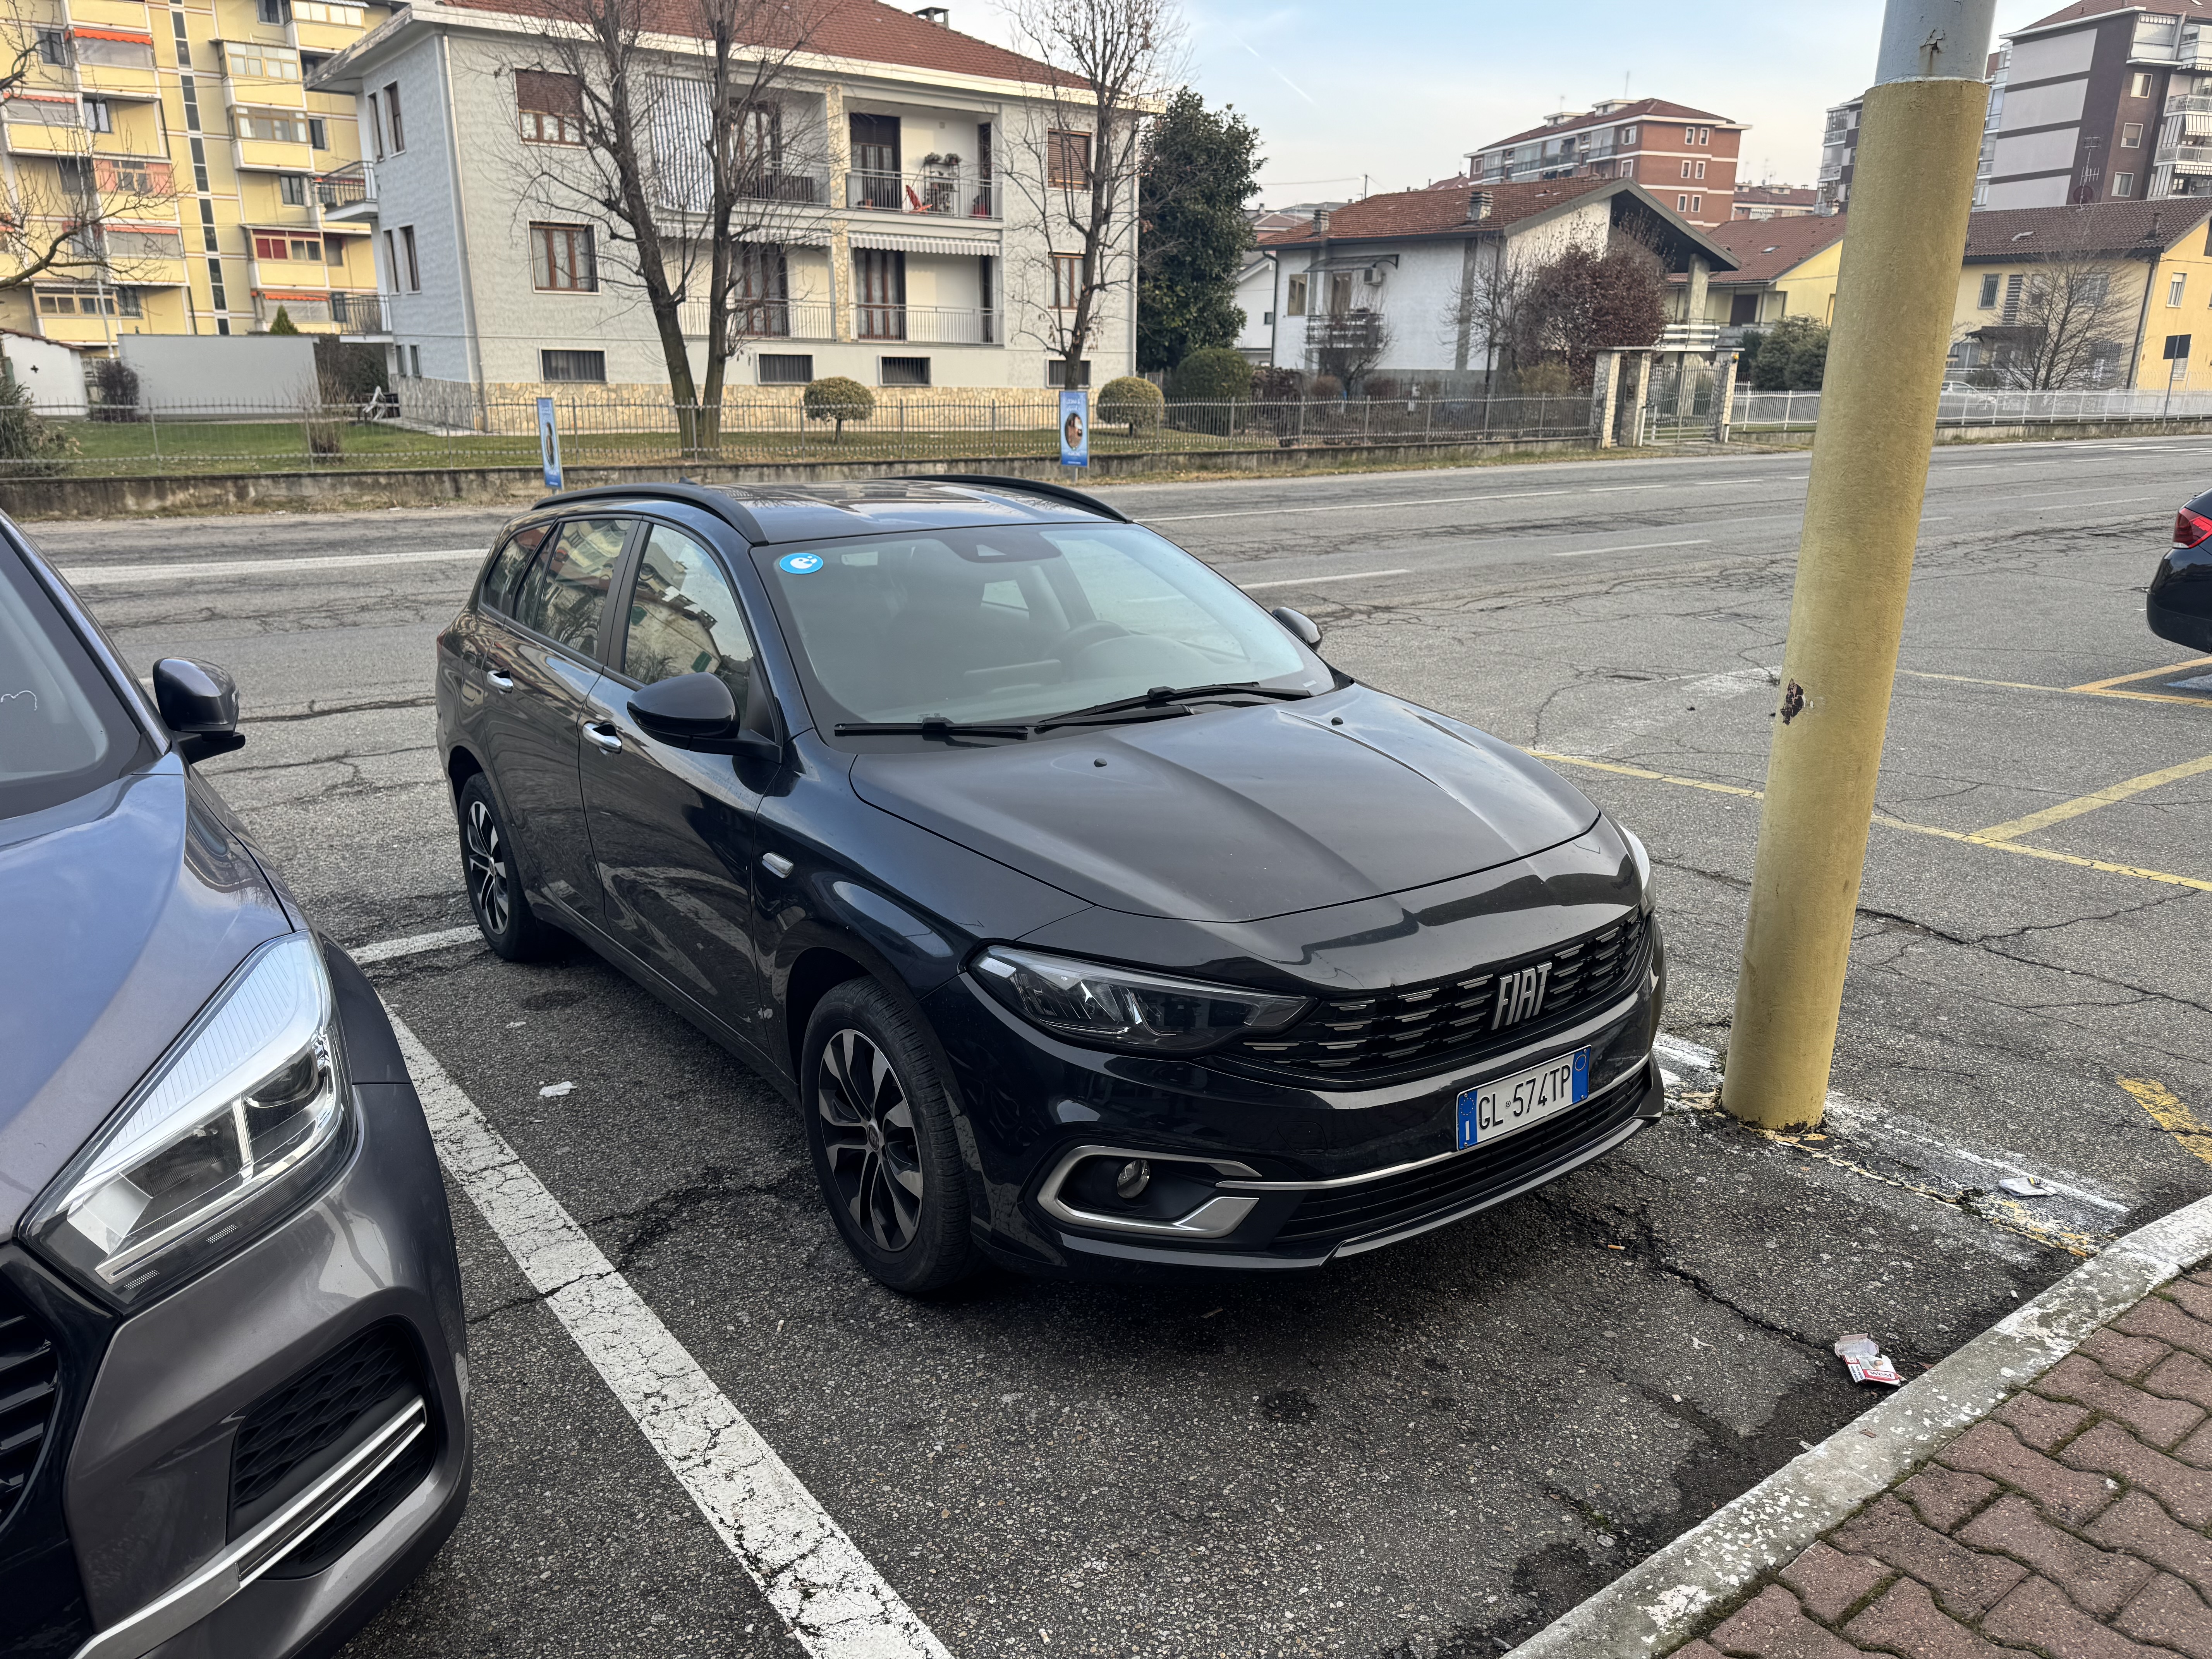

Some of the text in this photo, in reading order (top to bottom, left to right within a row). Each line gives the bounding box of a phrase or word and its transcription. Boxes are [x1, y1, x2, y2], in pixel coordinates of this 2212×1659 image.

[1491, 962, 1552, 1030] FIAT
[1465, 1120, 1470, 1140] I
[1479, 1065, 1571, 1130] GL 574TP
